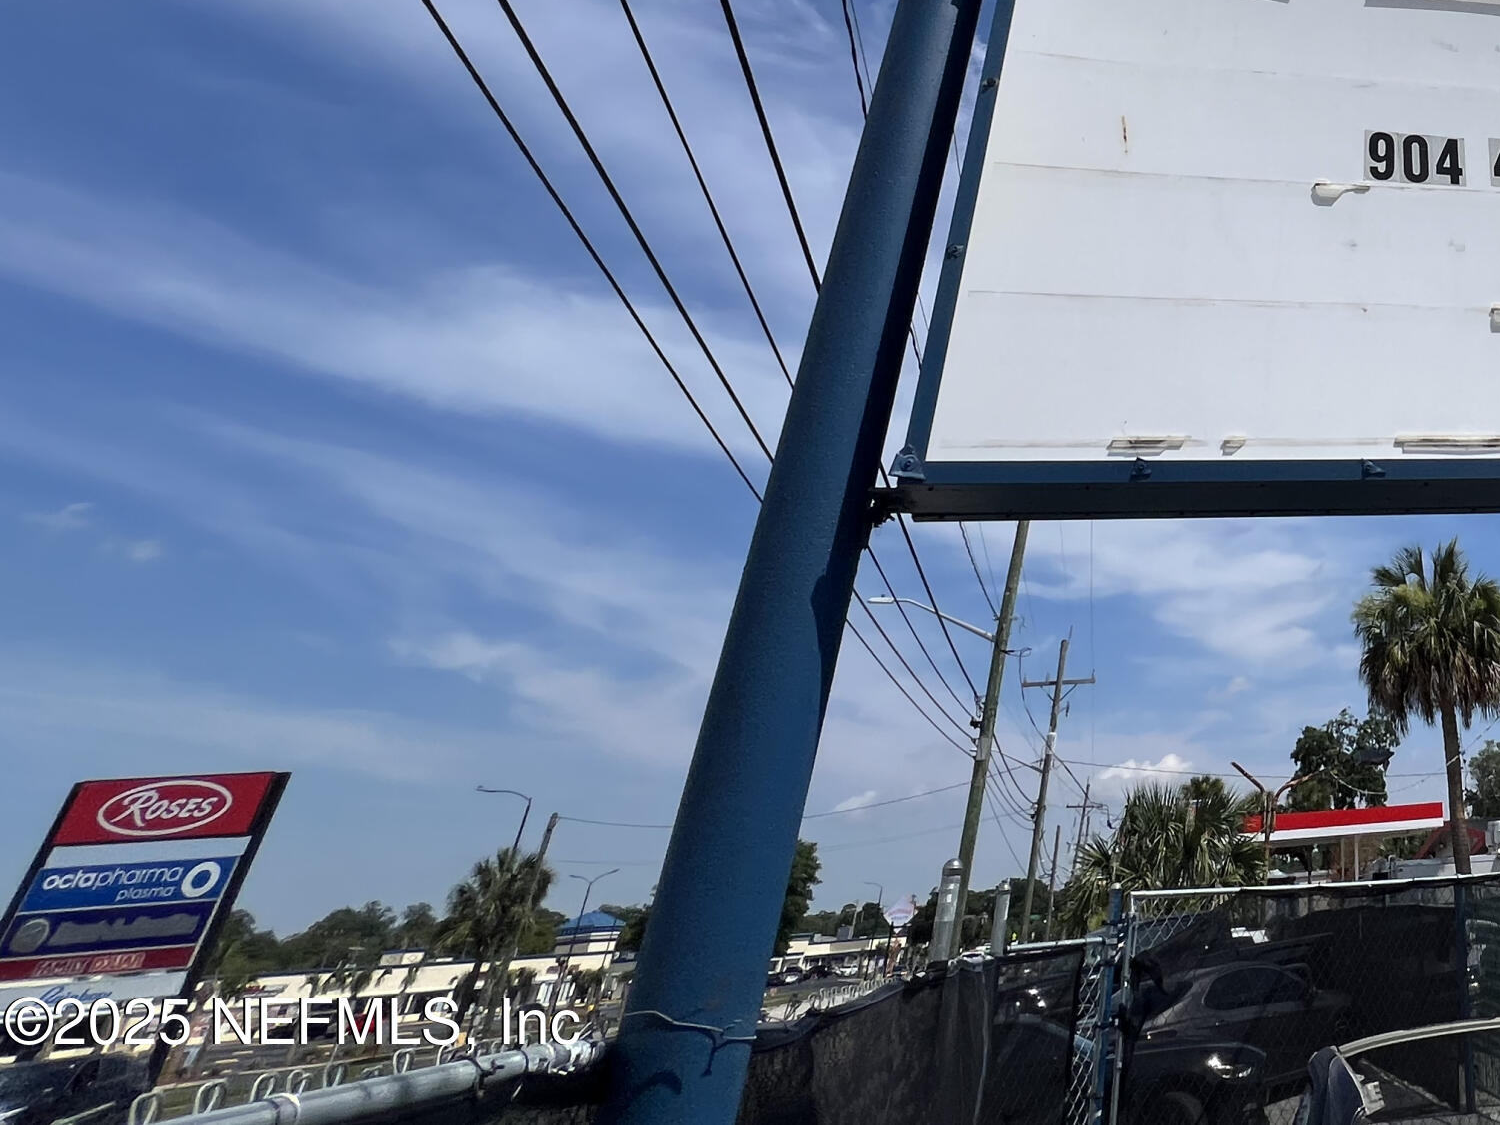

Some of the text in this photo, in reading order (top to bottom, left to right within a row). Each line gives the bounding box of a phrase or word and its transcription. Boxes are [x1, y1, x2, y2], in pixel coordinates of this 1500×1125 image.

[1368, 131, 1463, 185] 904
[42, 866, 184, 891] octapharma
[114, 885, 177, 902] plasma
